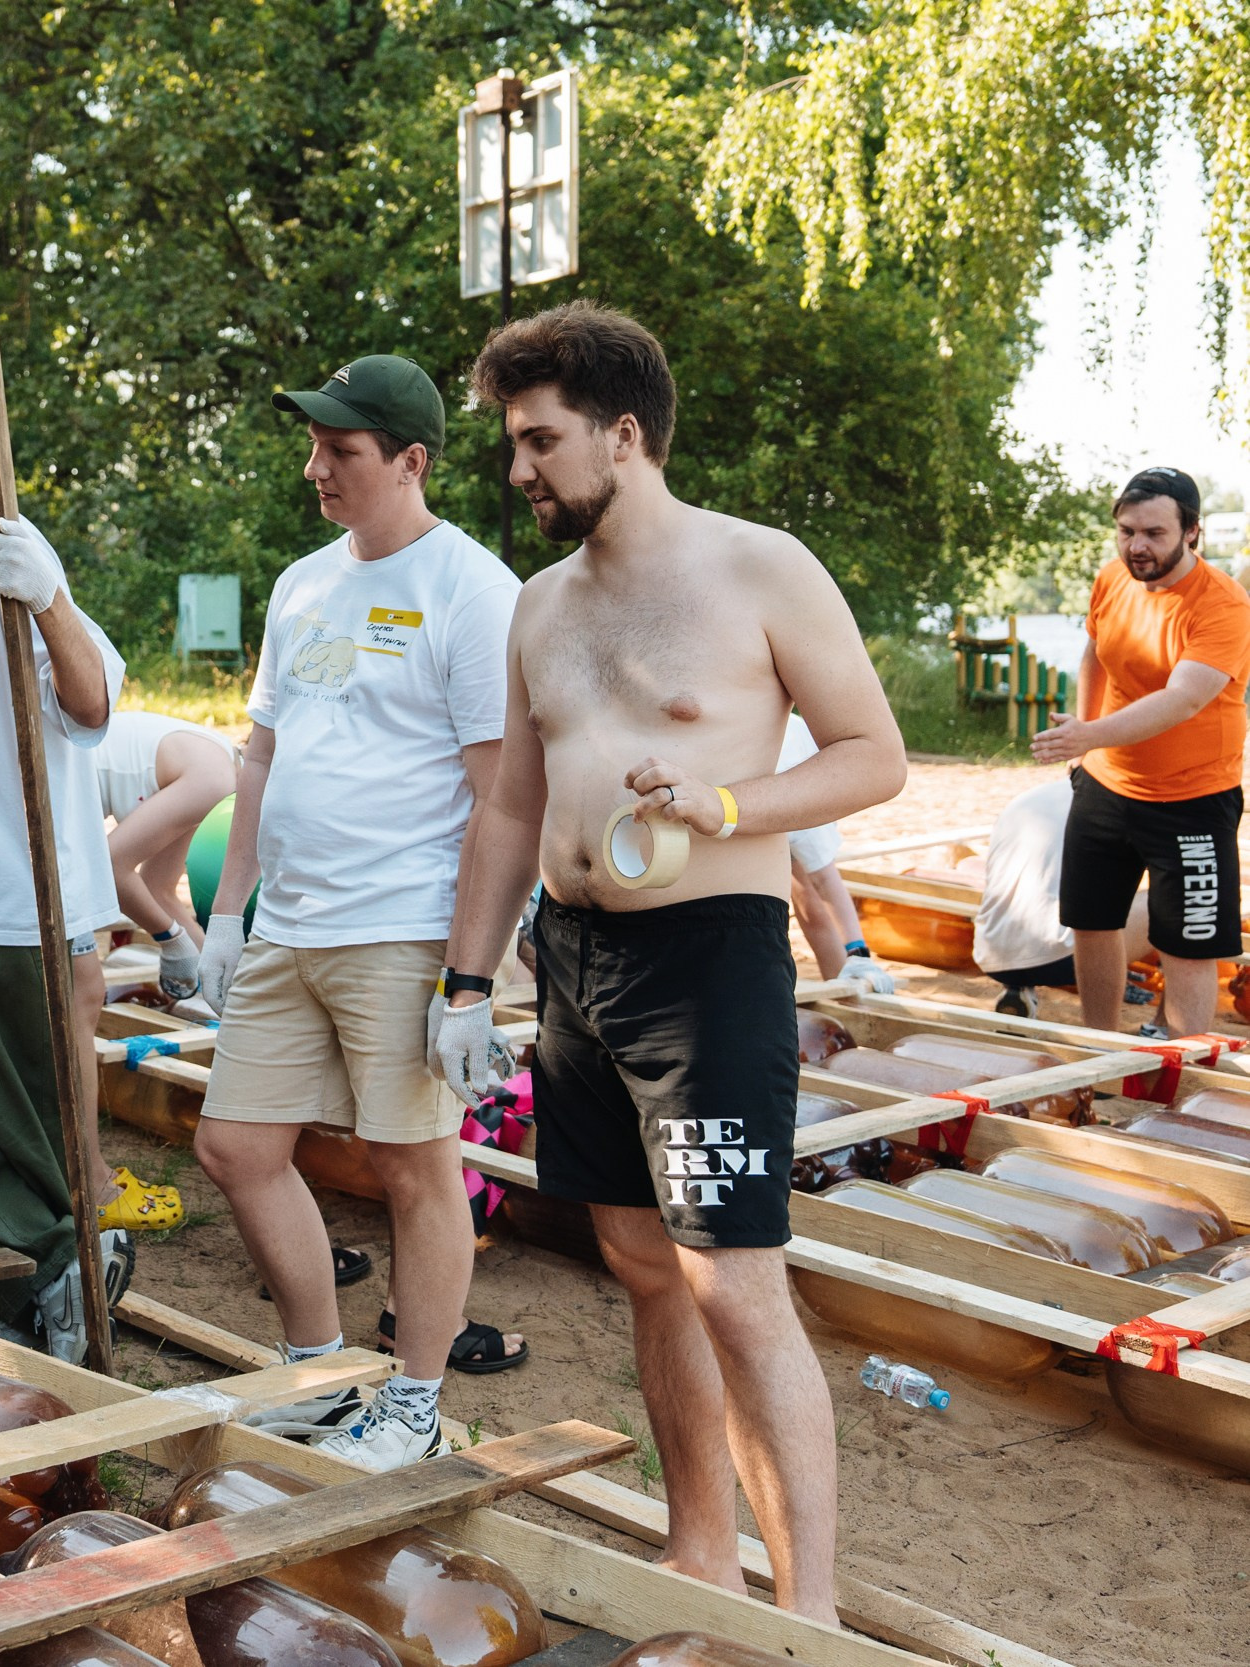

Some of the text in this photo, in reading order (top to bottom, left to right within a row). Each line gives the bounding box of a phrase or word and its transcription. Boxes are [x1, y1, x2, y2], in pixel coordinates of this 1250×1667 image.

[1177, 834, 1218, 940] INFERNO
[658, 1118, 745, 1145] TE
[663, 1148, 770, 1175] RM
[666, 1178, 734, 1206] IT
